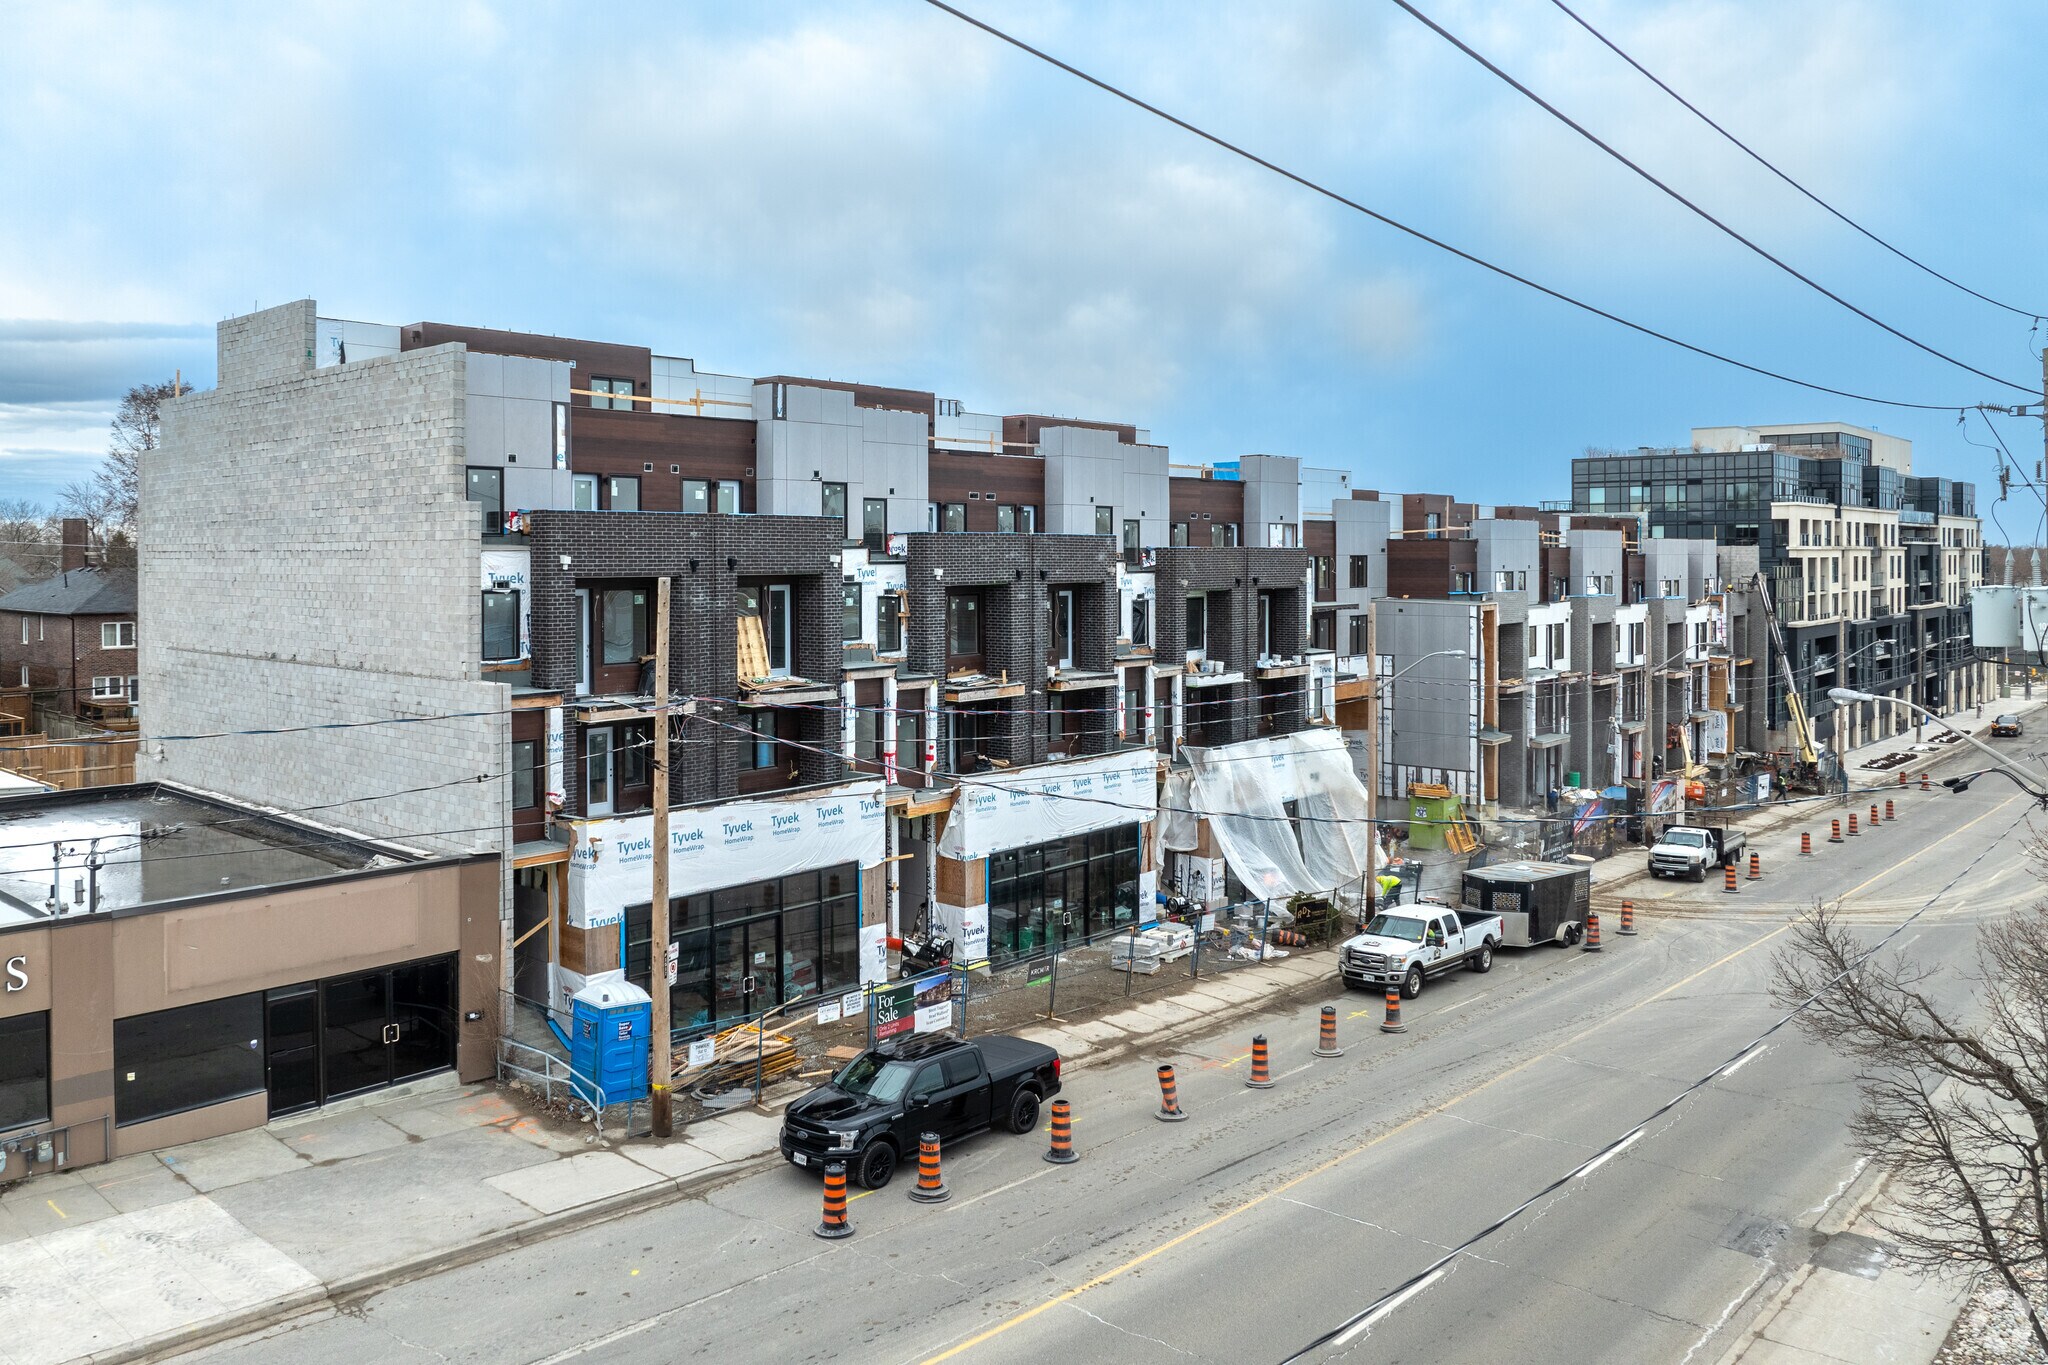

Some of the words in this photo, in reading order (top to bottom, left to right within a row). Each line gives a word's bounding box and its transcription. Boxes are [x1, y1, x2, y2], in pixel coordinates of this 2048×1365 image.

[1073, 777, 1092, 789] Tyvek
[1103, 771, 1120, 783] Tyvek
[1042, 782, 1061, 794] Tyvek
[816, 805, 843, 821] Tyvek
[859, 800, 883, 813] Tyve
[771, 812, 799, 828] Tyvek
[817, 818, 844, 828] HomeWrap
[723, 820, 753, 837] Tyvek
[772, 826, 800, 836] HomeWrap
[671, 829, 704, 846] Tyvek
[724, 834, 754, 845] HomeWrap
[617, 837, 651, 855] Tyvek
[673, 844, 705, 854] HomeWrap
[619, 853, 652, 864] HomeWrap
[962, 924, 985, 939] Tyvek
[7, 956, 29, 993] S
[878, 994, 896, 1010] For
[878, 1007, 899, 1025] Sale
